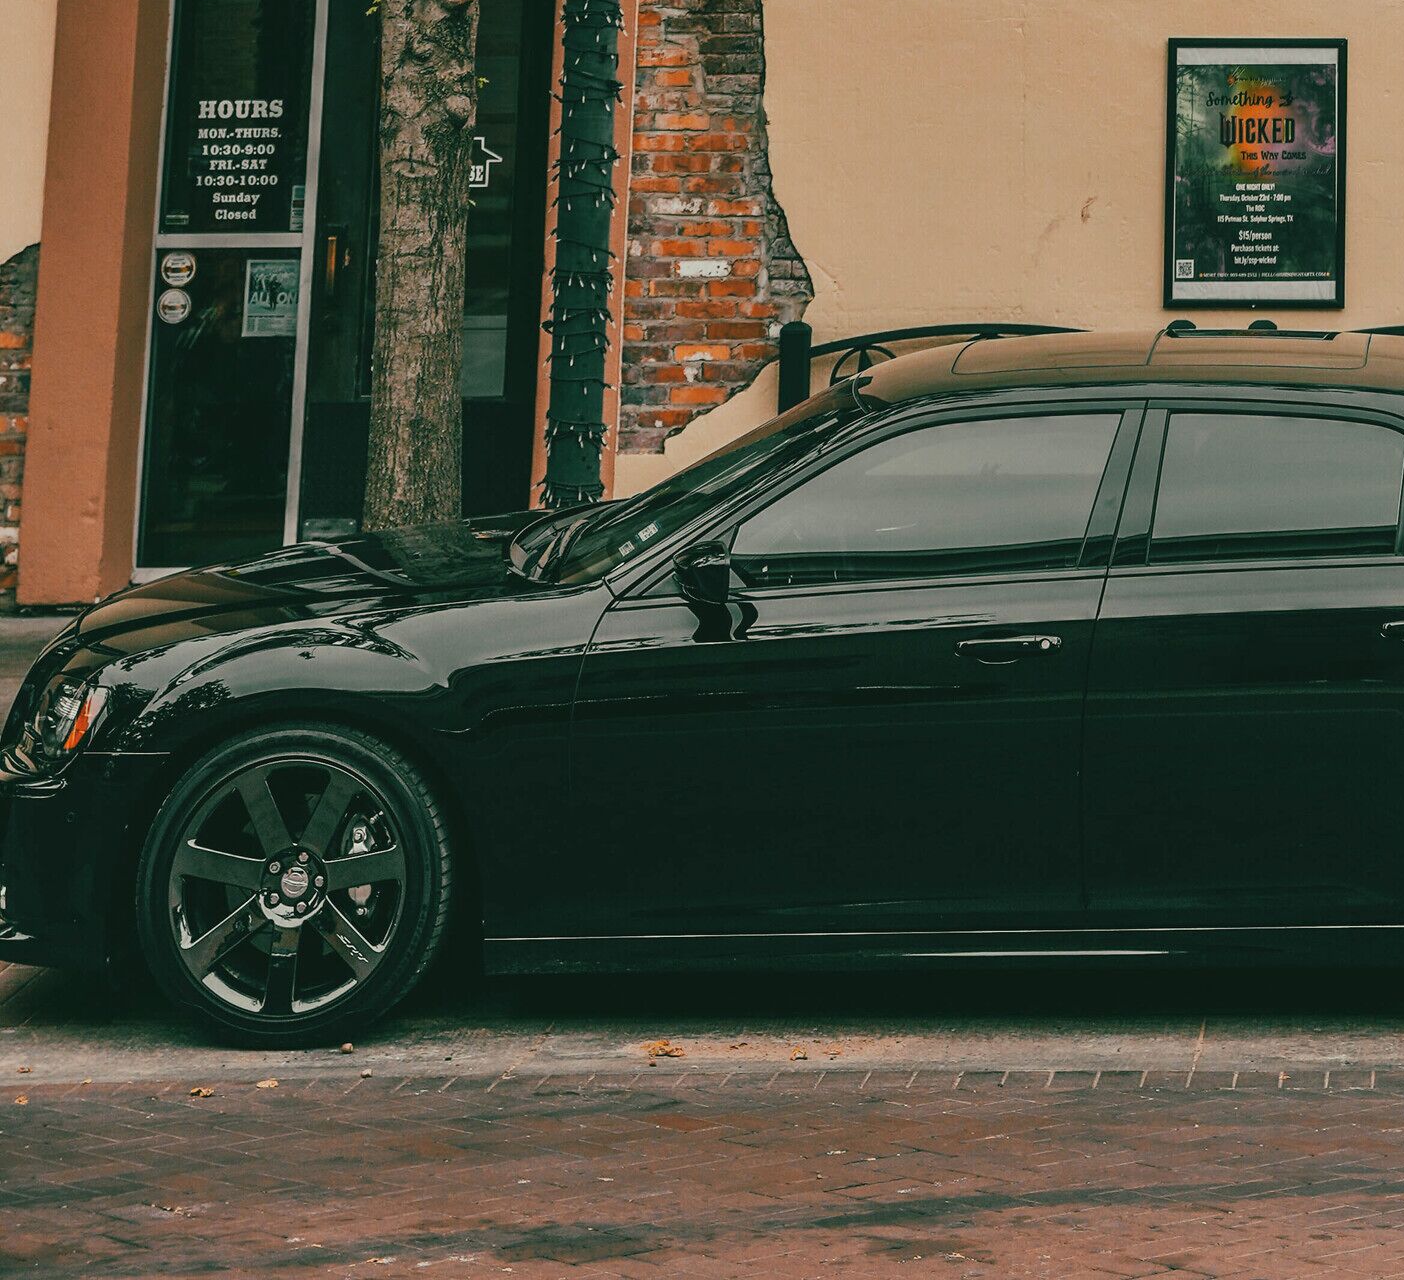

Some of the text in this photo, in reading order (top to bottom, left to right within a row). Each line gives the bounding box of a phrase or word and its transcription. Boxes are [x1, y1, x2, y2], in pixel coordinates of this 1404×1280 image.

[1205, 90, 1273, 109] Something
[198, 99, 284, 119] HOURS
[198, 127, 282, 139] MON.-THURS.
[1219, 112, 1295, 148] WICKED
[201, 144, 275, 156] 10:30-9:00
[195, 175, 278, 187] 10:30-10:00
[212, 192, 260, 205] Sunday
[214, 209, 257, 220] Closed
